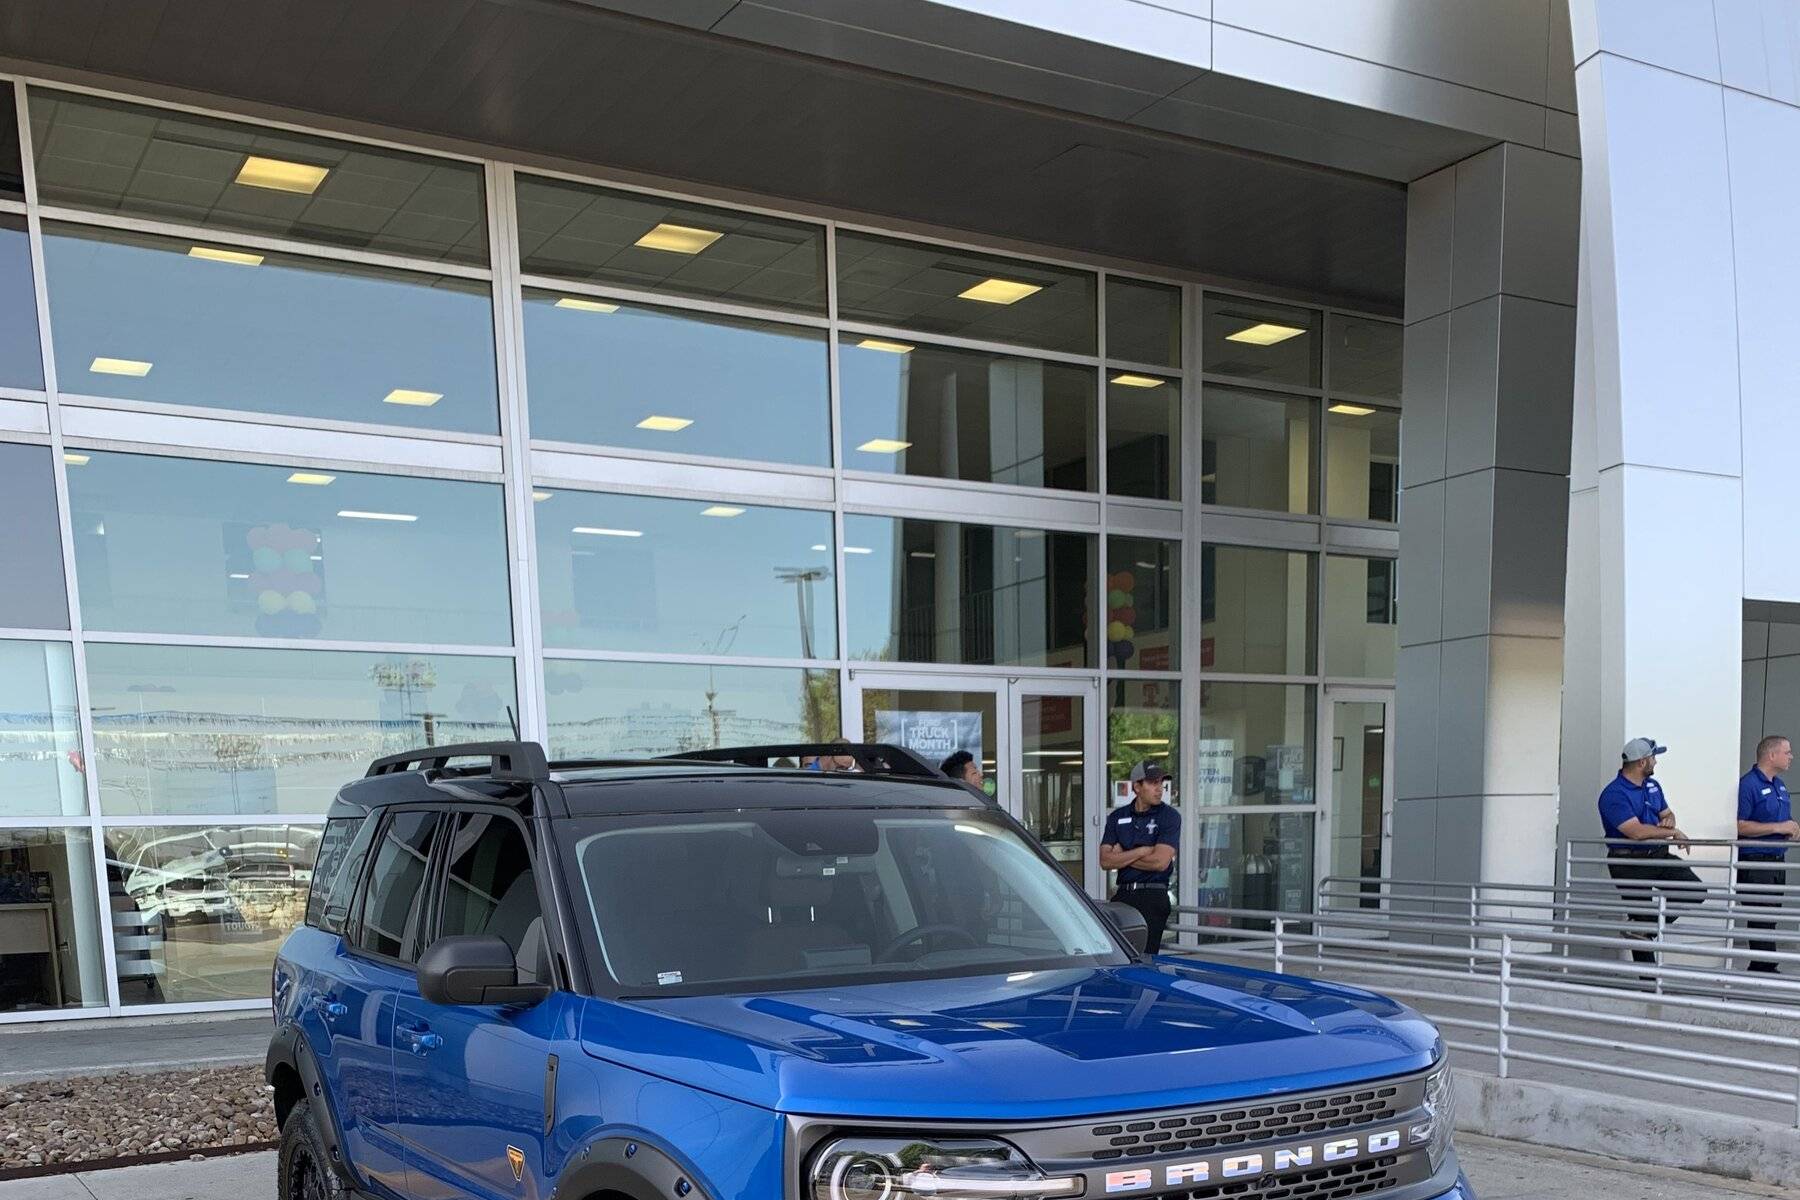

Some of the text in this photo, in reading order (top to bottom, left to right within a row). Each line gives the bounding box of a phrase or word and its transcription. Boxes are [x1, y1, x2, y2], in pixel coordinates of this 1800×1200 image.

[908, 727, 950, 739] TRUCK
[908, 739, 951, 750] MONTH
[1105, 1130, 1401, 1193] BRONCO
